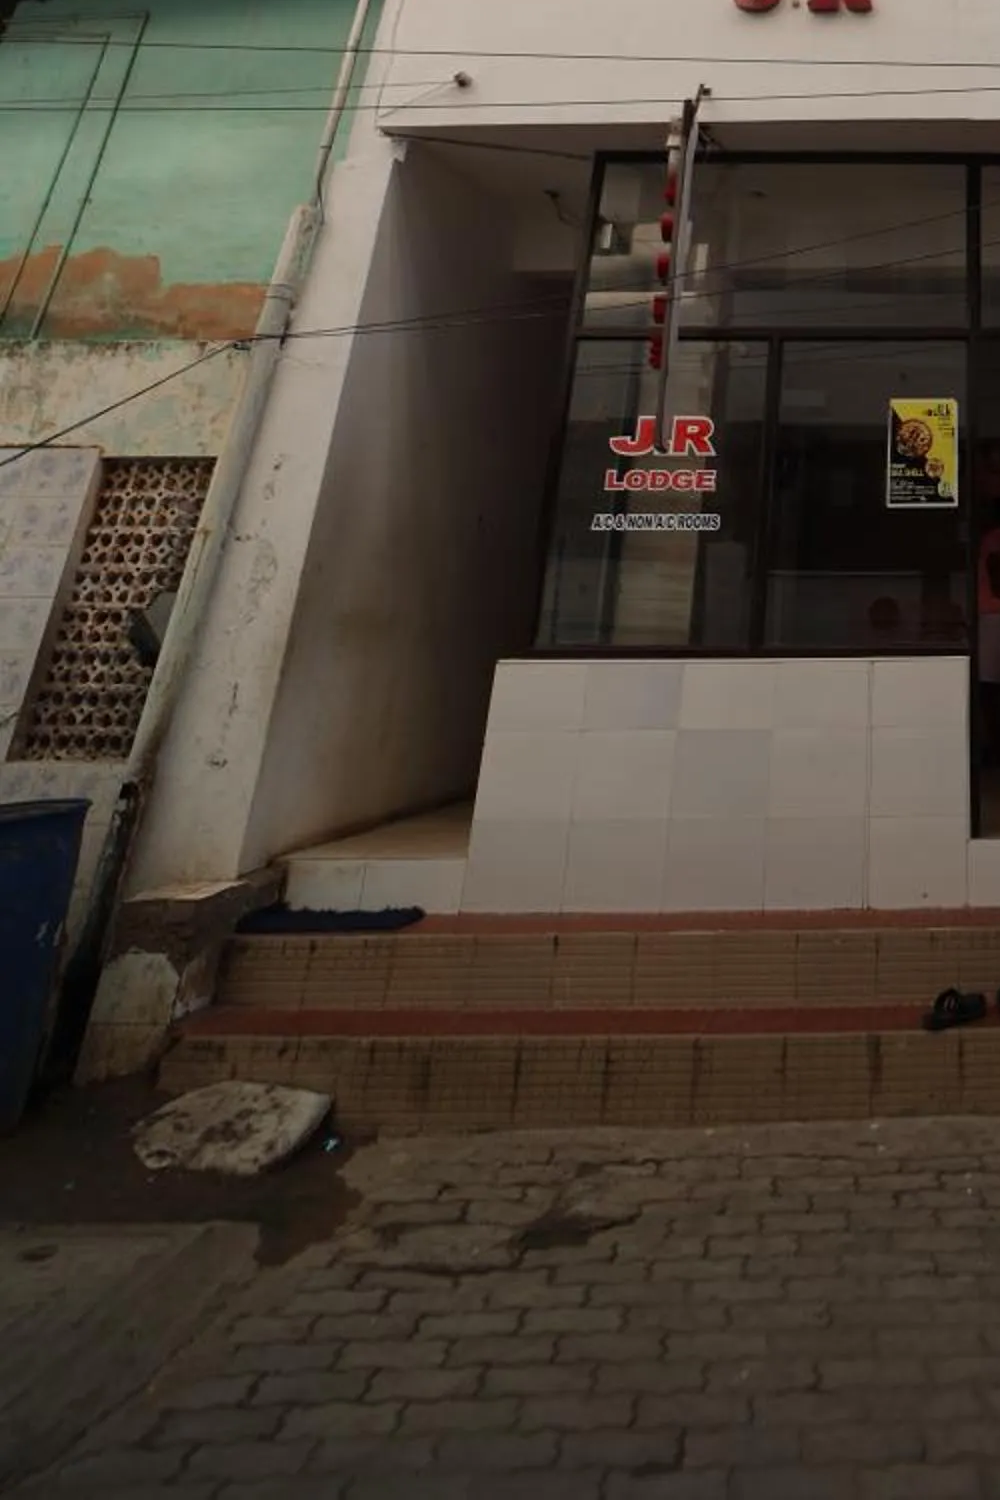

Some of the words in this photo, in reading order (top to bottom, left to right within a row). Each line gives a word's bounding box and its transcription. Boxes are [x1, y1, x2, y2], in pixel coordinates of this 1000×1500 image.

[604, 469, 717, 491] LODGE
[626, 514, 655, 530] NON
[676, 514, 720, 530] ROOMS
